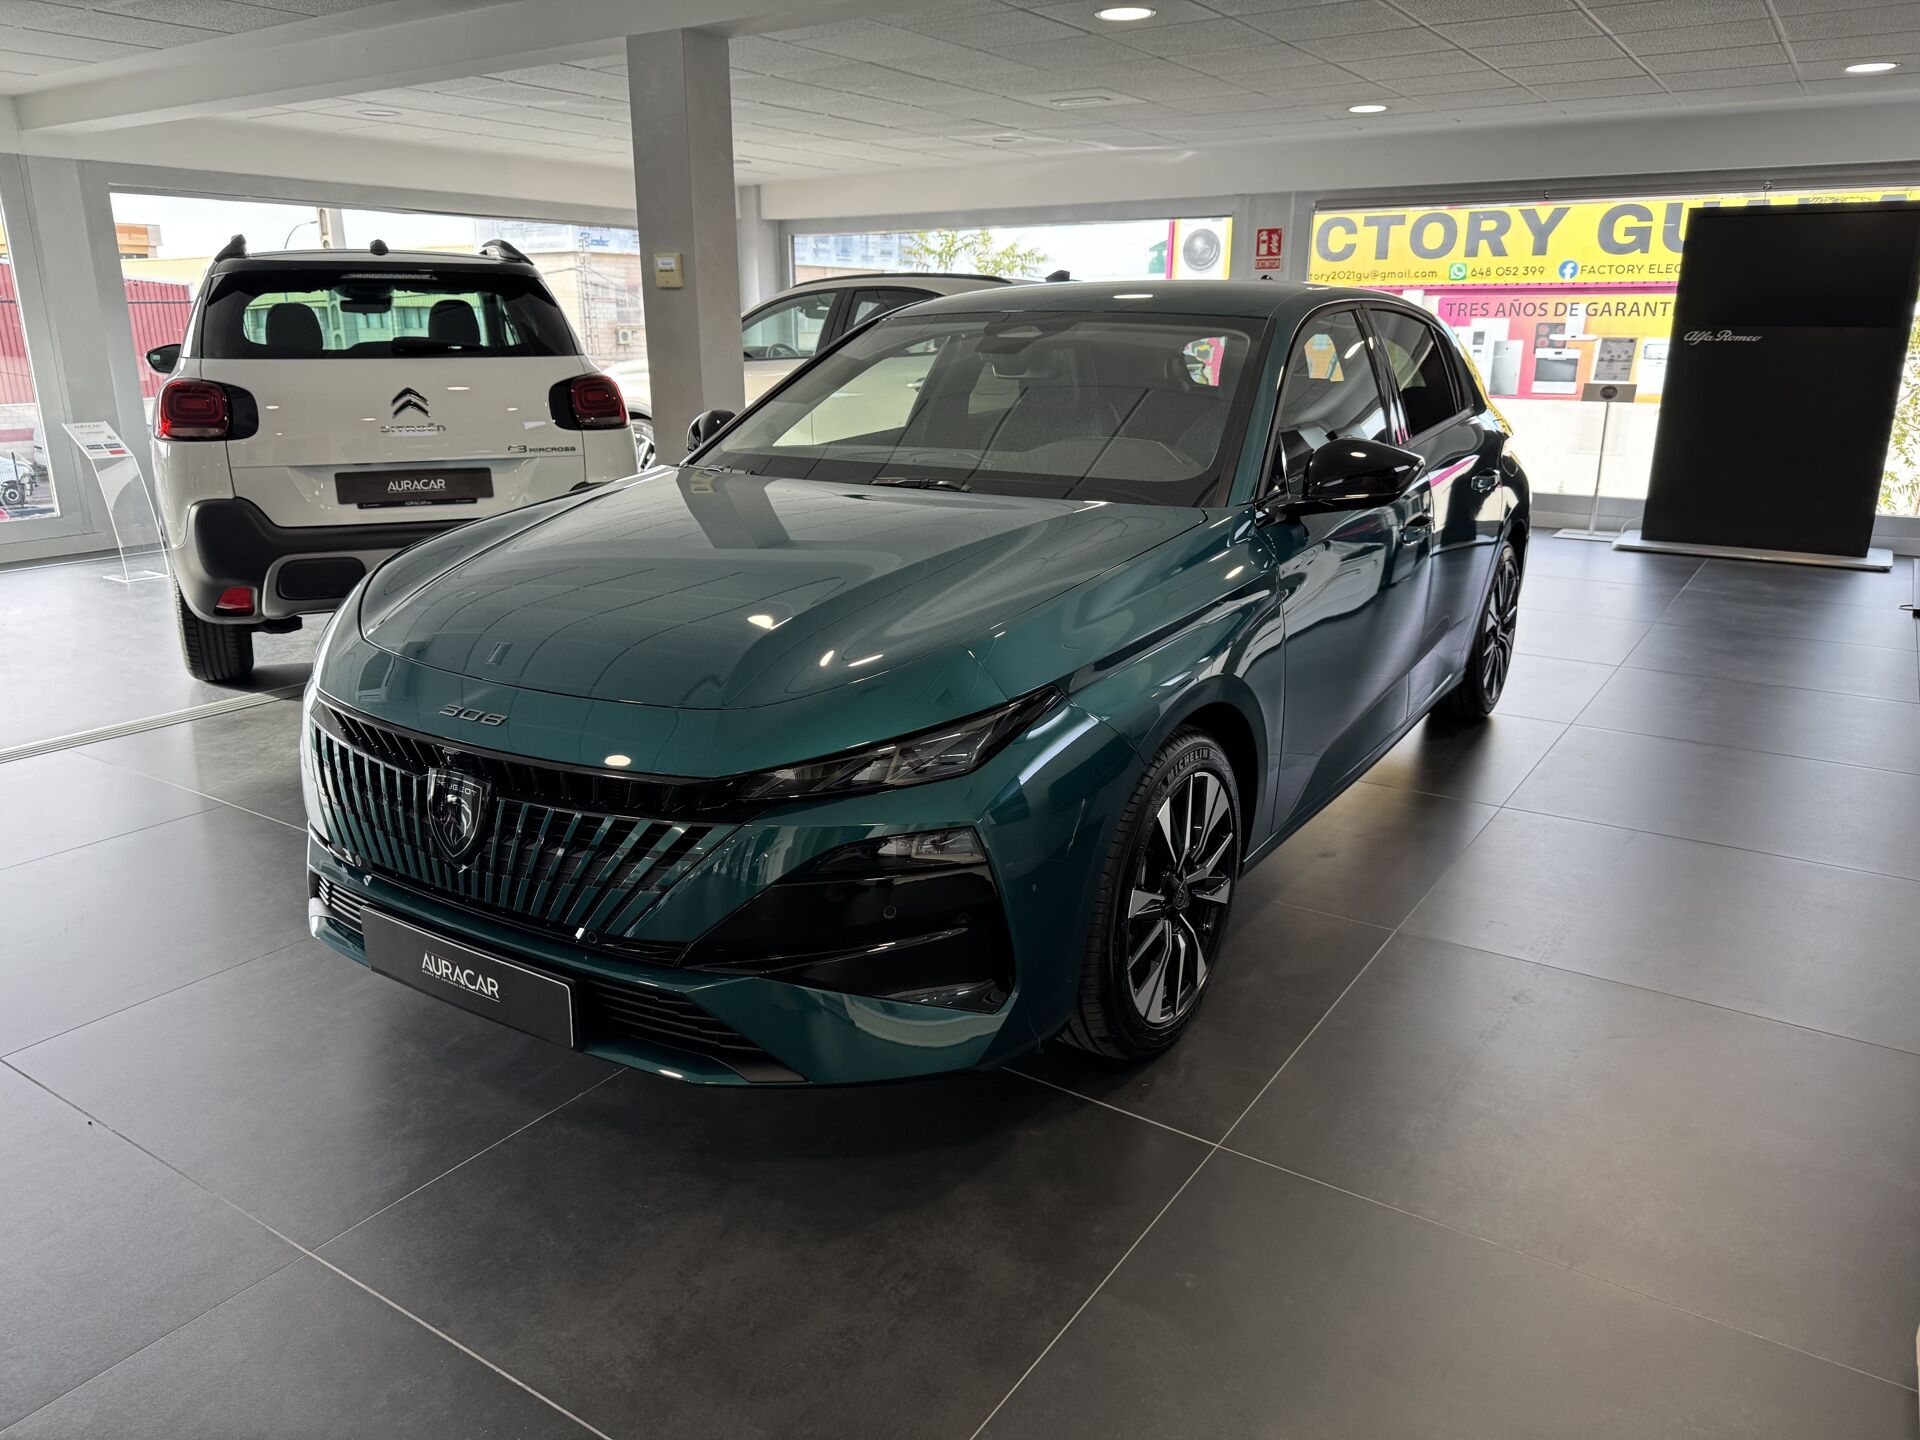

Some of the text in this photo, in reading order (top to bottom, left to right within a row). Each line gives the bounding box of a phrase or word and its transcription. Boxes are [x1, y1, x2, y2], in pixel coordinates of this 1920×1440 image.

[1315, 206, 1571, 262] CTORY
[1470, 265, 1545, 277] 648 052 399
[1580, 264, 1645, 275] FACTORY
[1446, 302, 1489, 317] TRES
[1494, 299, 1548, 317] AÑOS
[1554, 302, 1580, 317] DE
[1683, 329, 1763, 345] Alfa Romeo
[387, 478, 446, 491] AURACAR
[438, 704, 508, 727] 308
[1166, 748, 1208, 785] MICHELIN
[422, 952, 499, 999] AURACAR
